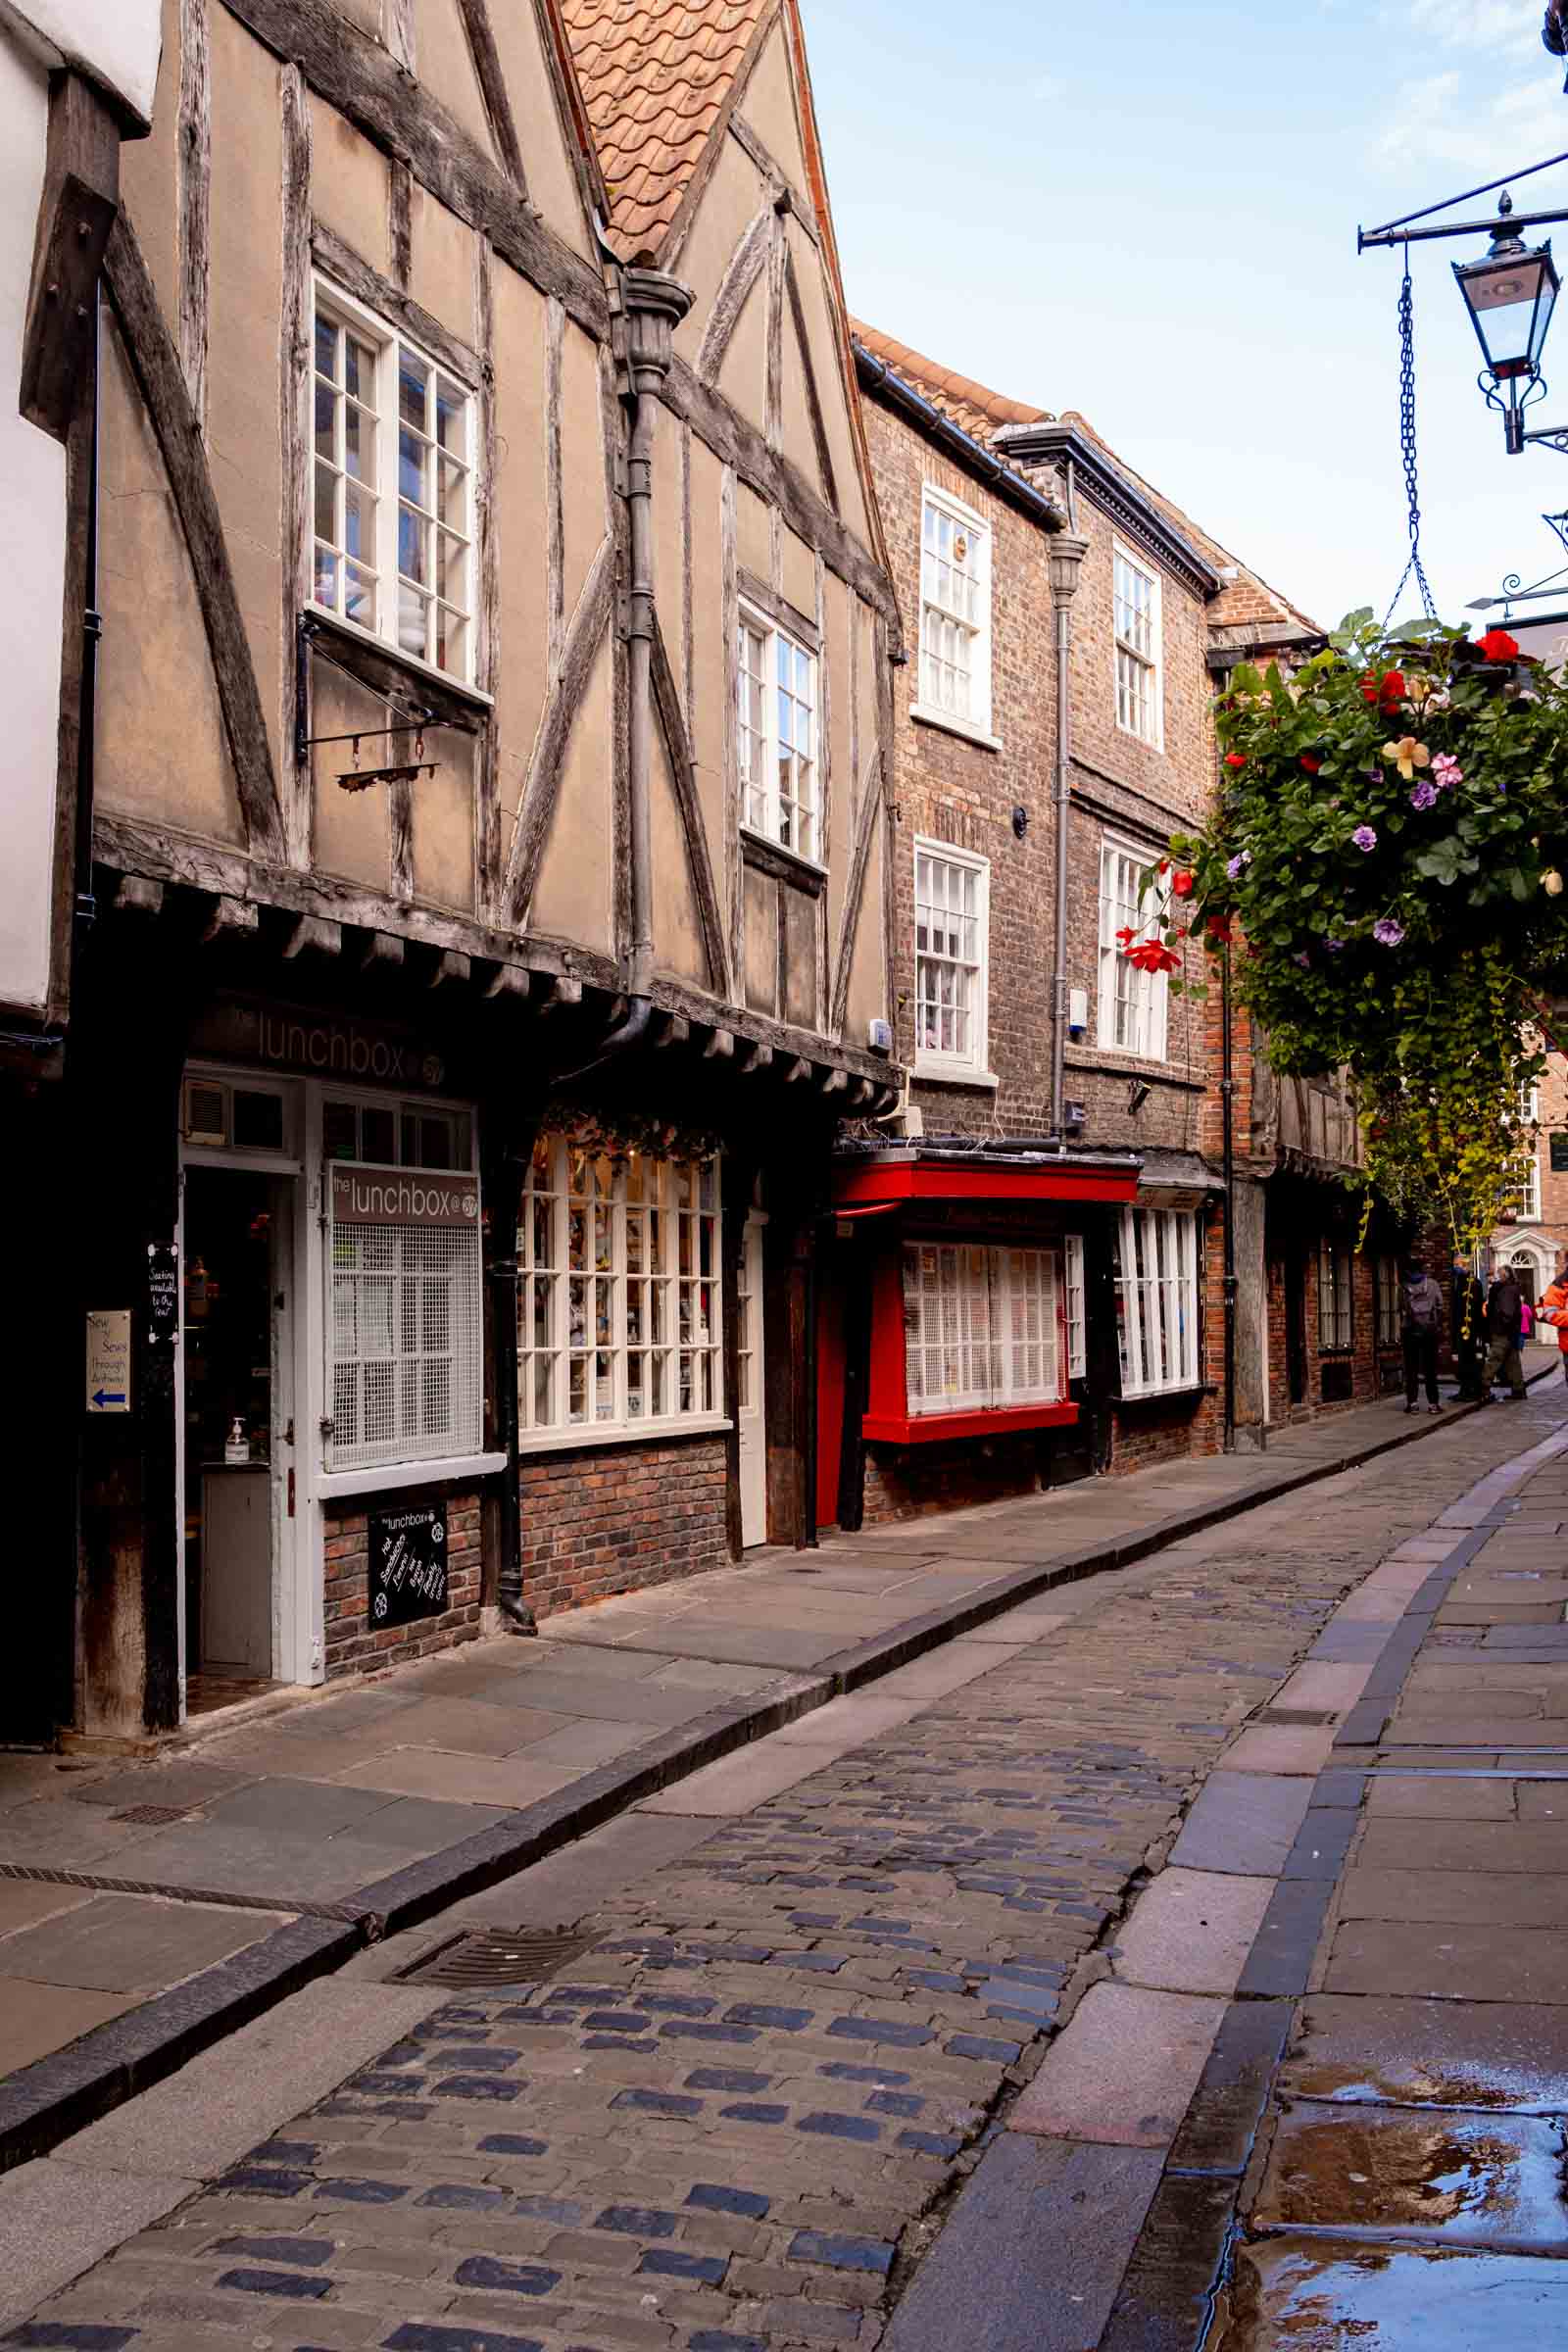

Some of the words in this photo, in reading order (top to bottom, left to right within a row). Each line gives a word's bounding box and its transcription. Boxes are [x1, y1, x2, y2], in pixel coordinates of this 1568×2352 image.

[259, 1010, 406, 1077] lunchbox
[334, 1176, 351, 1193] the
[353, 1176, 450, 1215] lunchbox
[451, 1195, 461, 1213] @
[148, 1267, 174, 1286] Seating
[388, 1512, 424, 1530] lunchbox
[381, 1537, 393, 1555] Hot
[410, 1560, 423, 1588] Bacon
